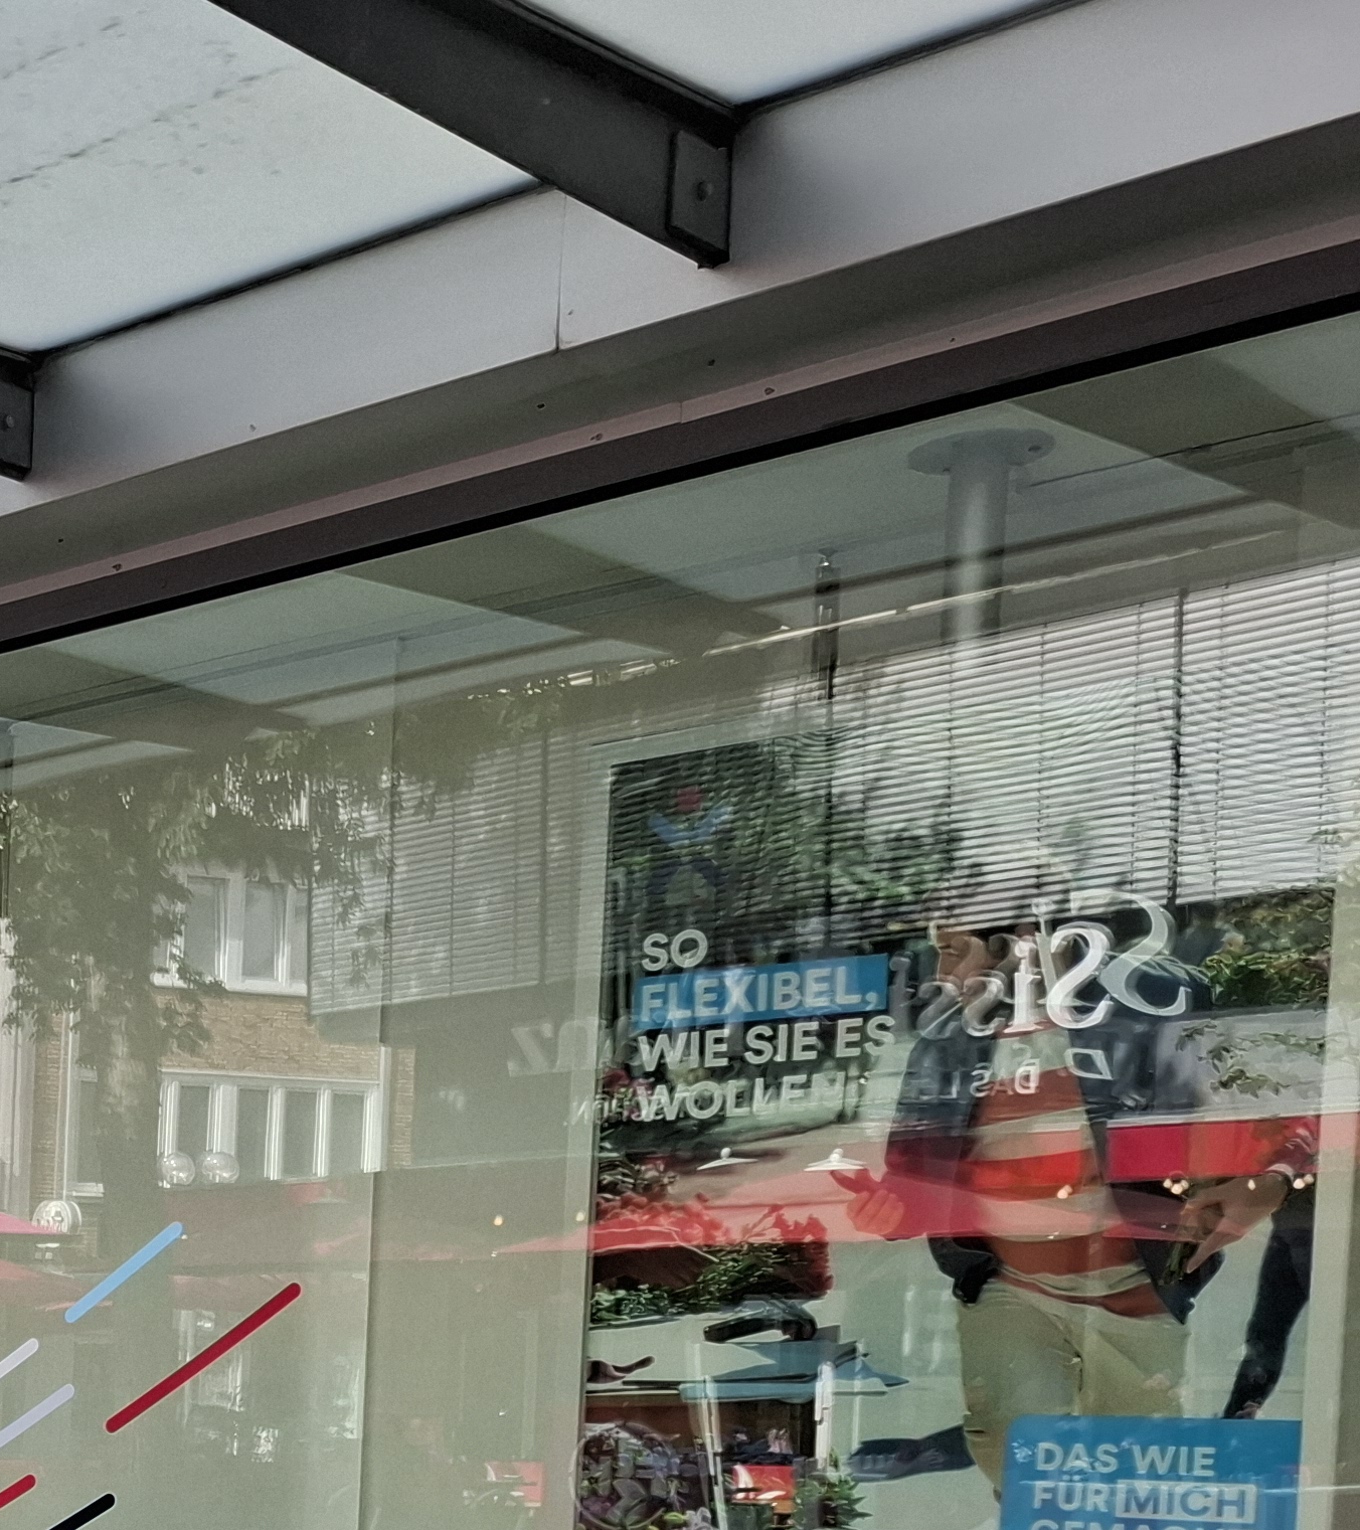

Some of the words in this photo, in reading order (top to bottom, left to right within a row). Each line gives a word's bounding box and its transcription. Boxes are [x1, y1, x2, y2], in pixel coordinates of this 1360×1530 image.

[641, 928, 709, 972] SO
[640, 965, 879, 1022] FLEXIBEL,
[638, 1028, 730, 1072] WIE
[744, 1021, 819, 1065] SIE
[835, 1015, 896, 1058] ES
[1035, 1442, 1119, 1474] DAS
[1131, 1445, 1216, 1477] WIE
[1033, 1474, 1109, 1512] FÜR
[1123, 1484, 1248, 1519] MICH
